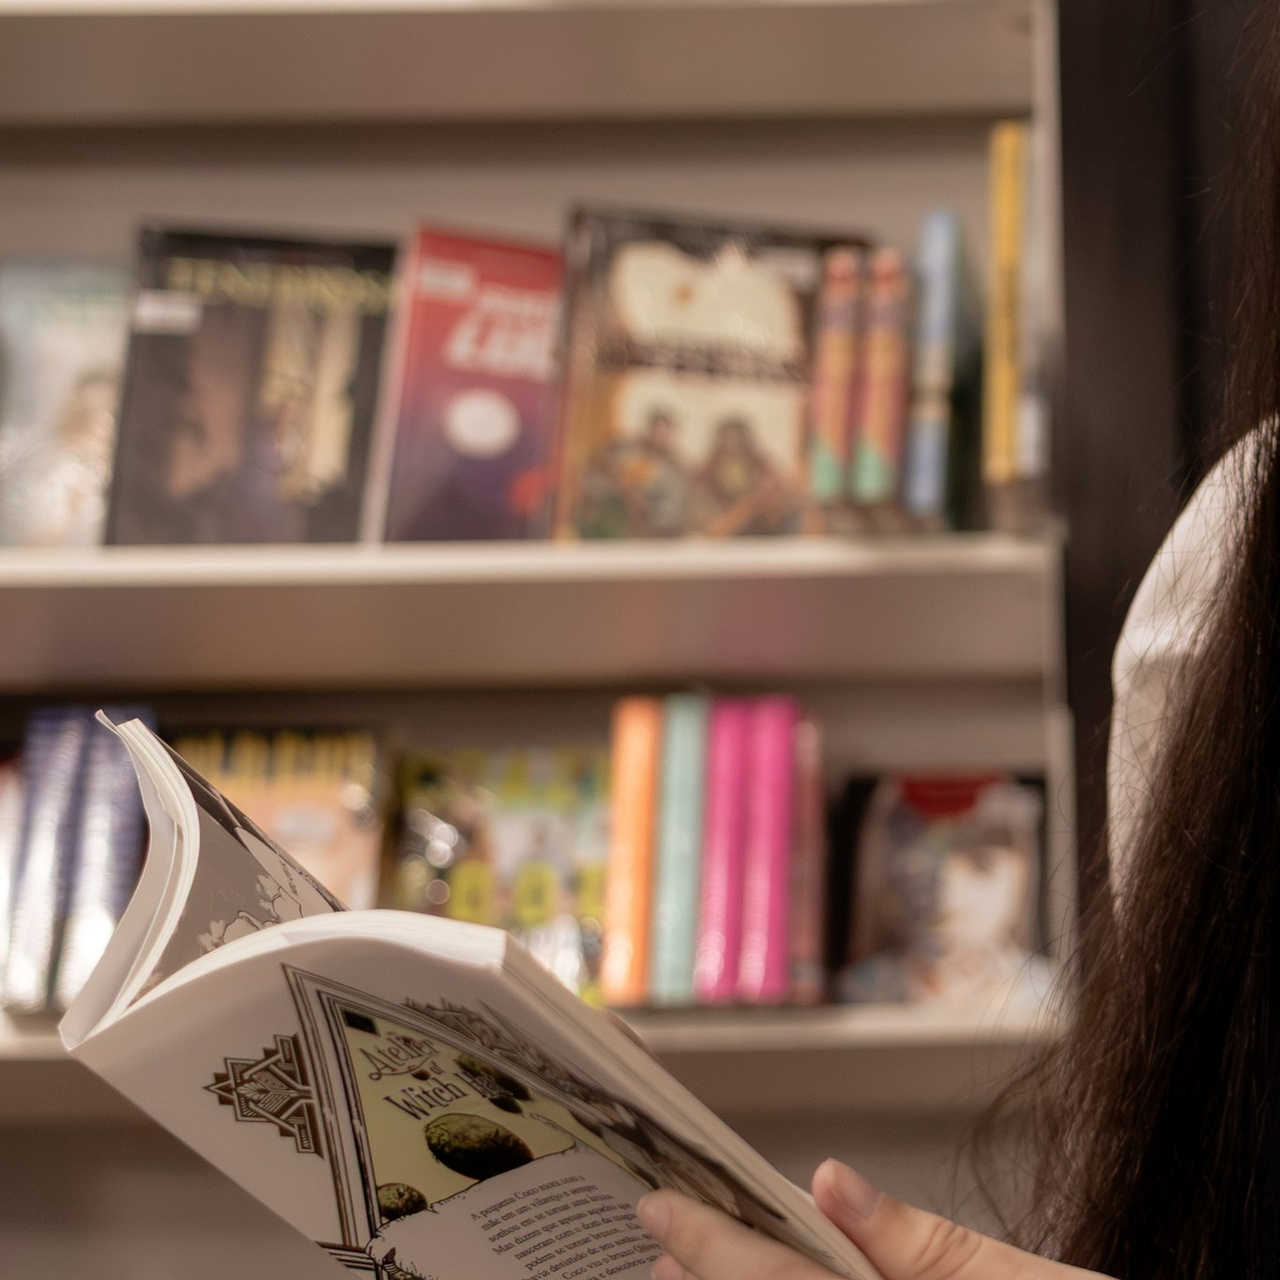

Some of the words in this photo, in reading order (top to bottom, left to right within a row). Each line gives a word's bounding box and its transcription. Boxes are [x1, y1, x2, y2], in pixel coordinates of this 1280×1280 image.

[360, 1031, 440, 1081] Atelier
[383, 1075, 470, 1120] Witch
[471, 1213, 481, 1221] A
[513, 1187, 539, 1199] Coco
[501, 1212, 517, 1221] em
[516, 1205, 532, 1214] um
[489, 1224, 520, 1243] sonhou
[520, 1217, 537, 1227] em
[492, 1241, 515, 1255] Mas
[514, 1229, 543, 1245] dizem
[541, 1222, 559, 1232] que
[514, 1238, 556, 1260] nasceram
[555, 1229, 576, 1241] com
[525, 1252, 556, 1271] podem
[564, 1236, 592, 1250] tornar
[549, 1252, 589, 1273] desistido
[586, 1247, 600, 1255] de
[562, 1266, 587, 1280] Coco
